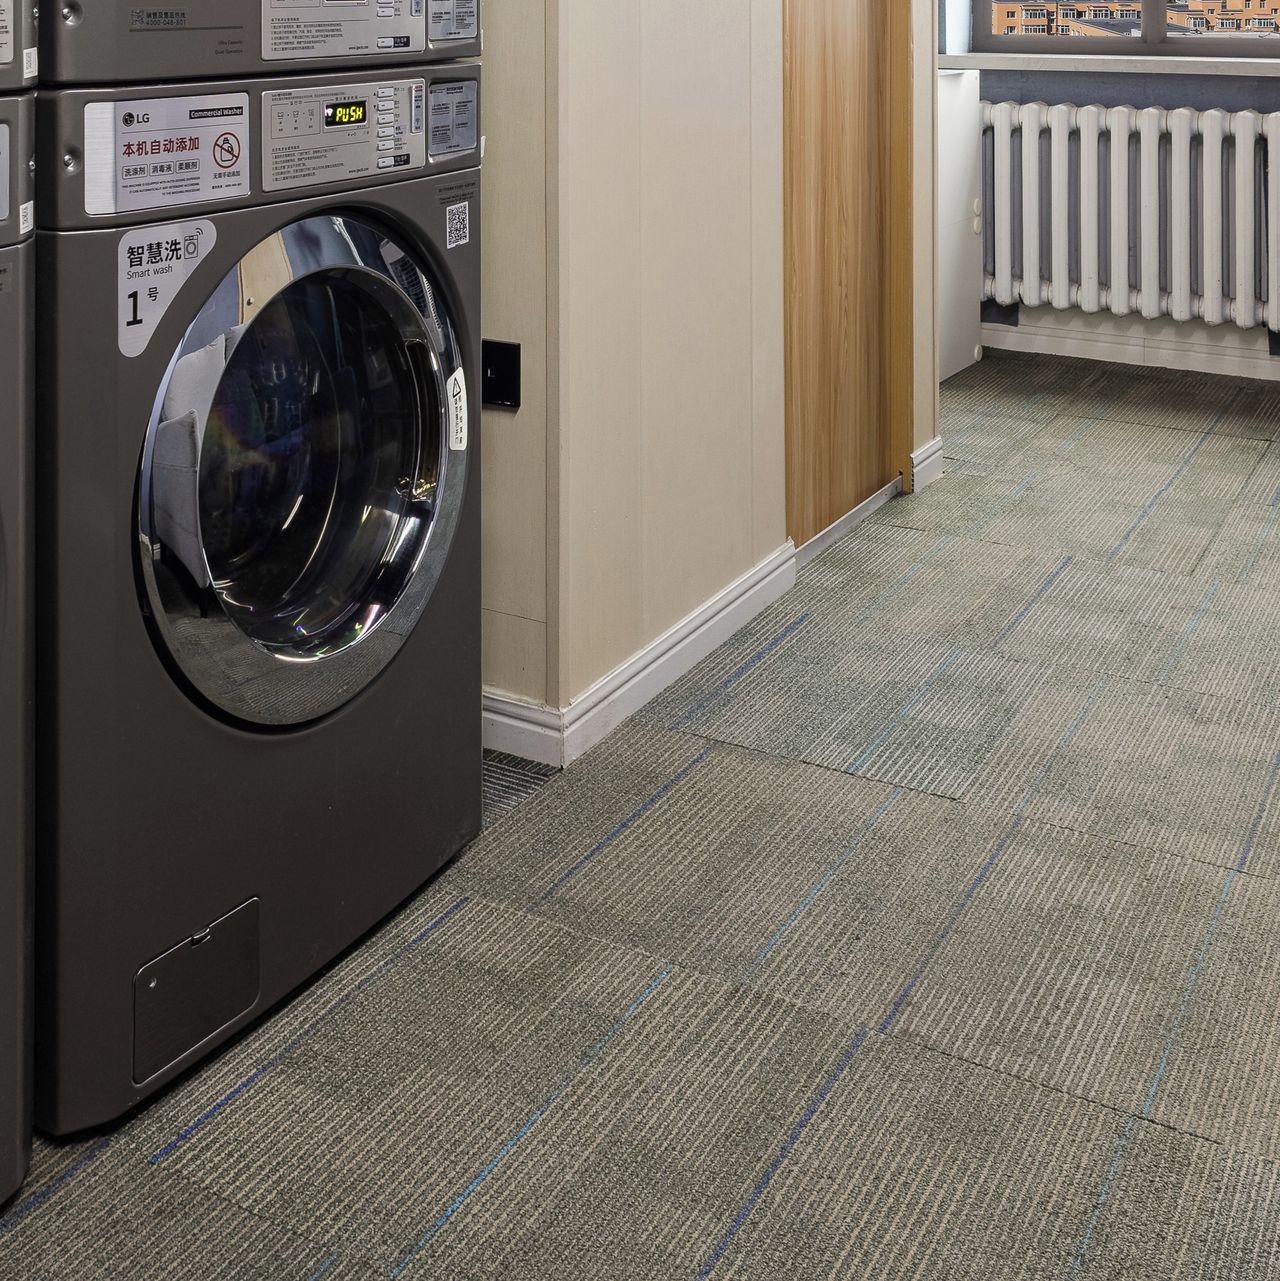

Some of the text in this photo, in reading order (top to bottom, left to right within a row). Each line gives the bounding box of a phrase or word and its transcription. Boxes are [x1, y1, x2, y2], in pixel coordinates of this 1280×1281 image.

[136, 113, 150, 124] LG
[191, 108, 243, 118] Commercial Washer
[336, 107, 363, 122] PUSH
[122, 136, 200, 157] 本机自动添加
[127, 239, 182, 268] 智慧洗
[126, 264, 173, 280] Smart wash
[126, 286, 159, 327] 1 号
